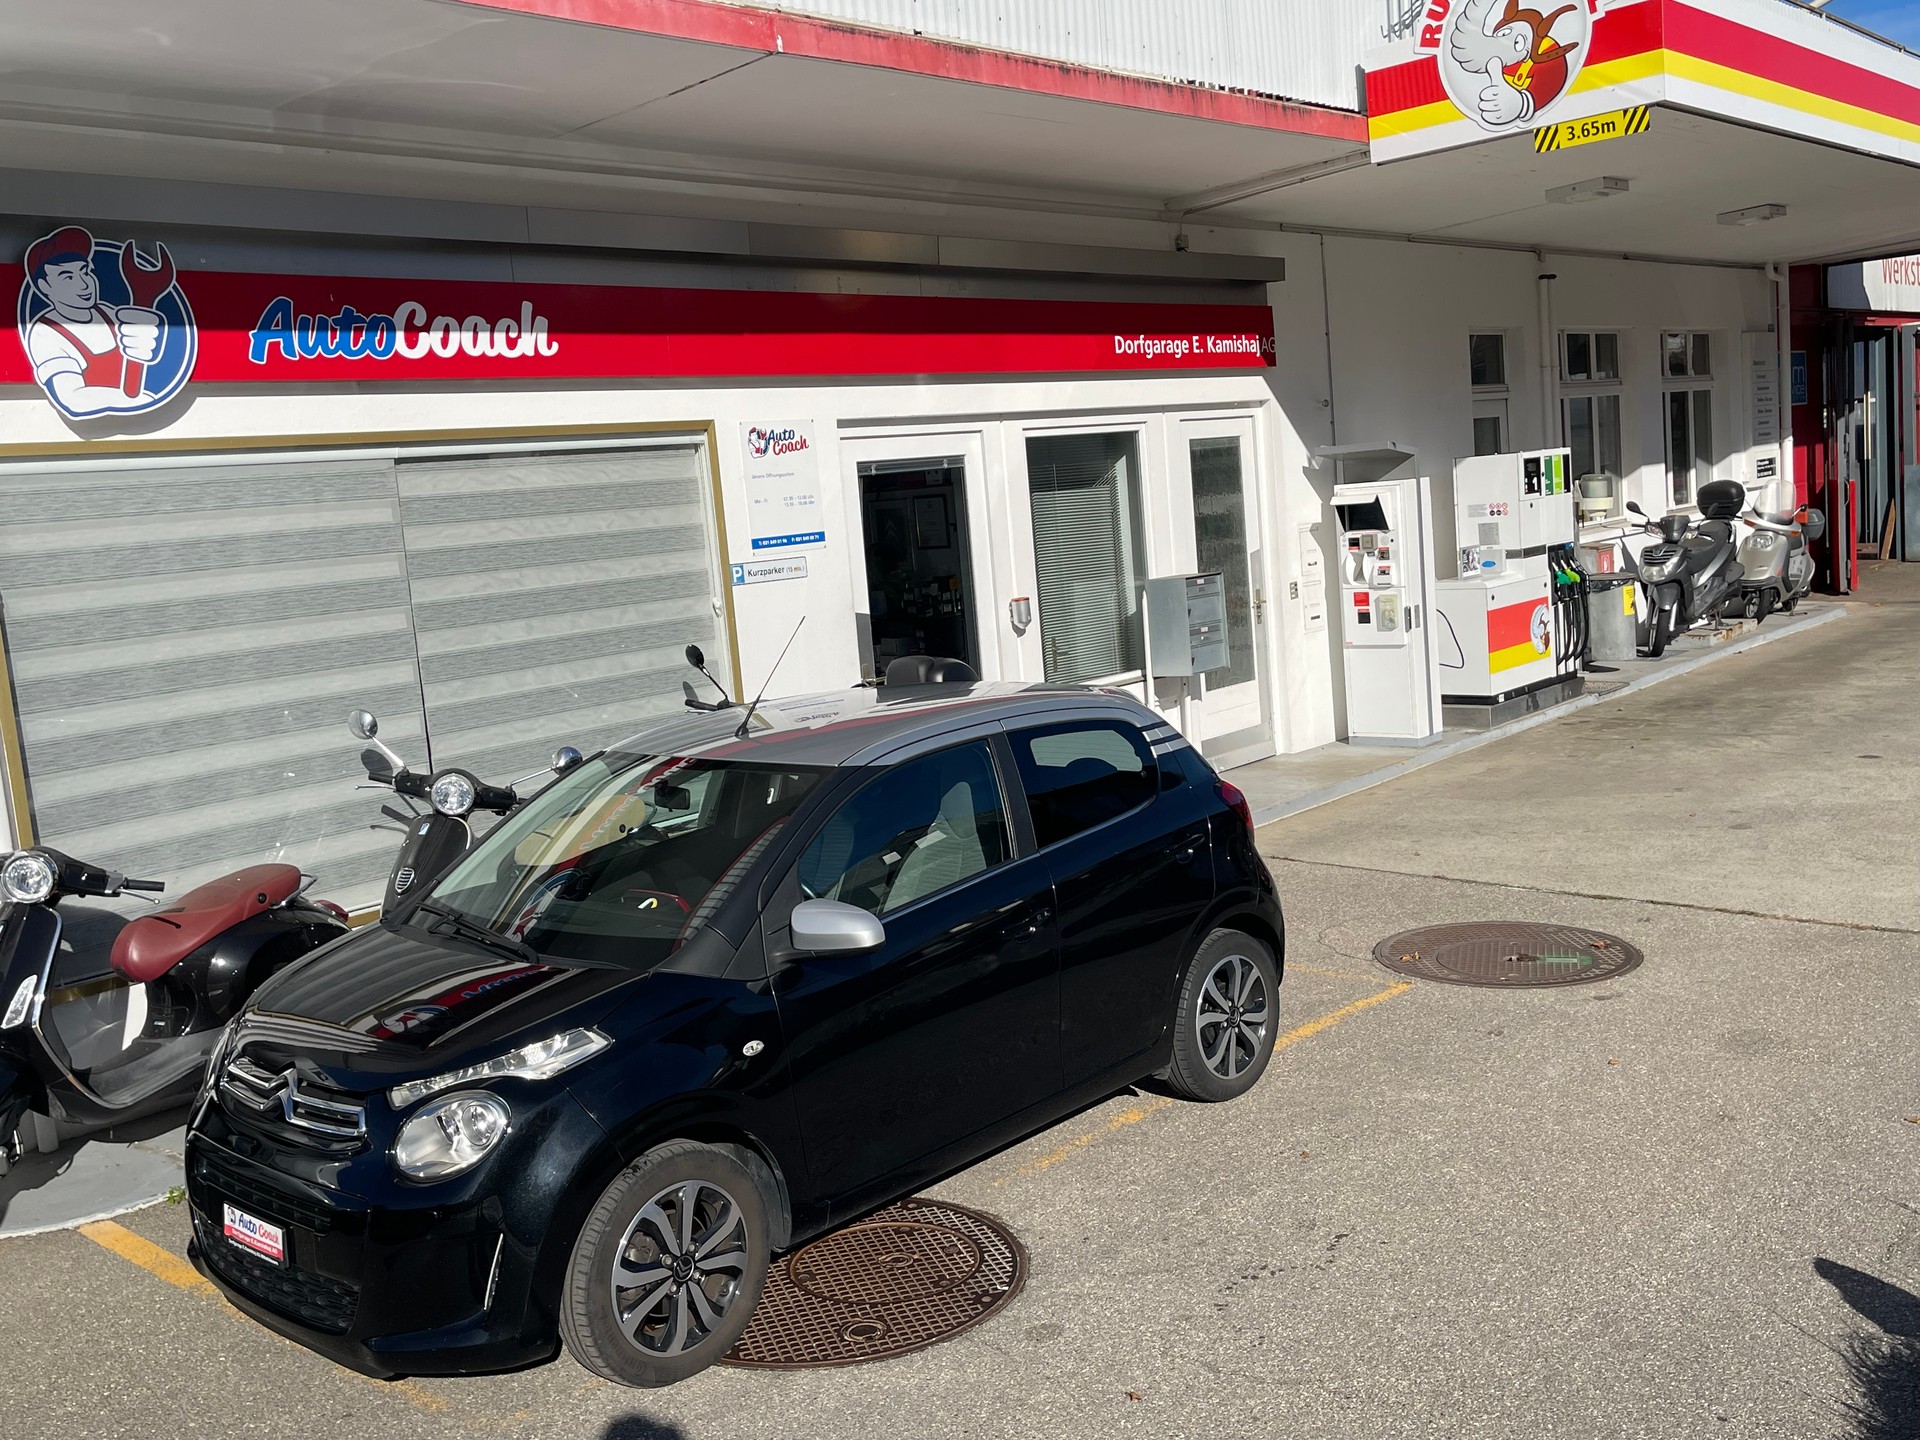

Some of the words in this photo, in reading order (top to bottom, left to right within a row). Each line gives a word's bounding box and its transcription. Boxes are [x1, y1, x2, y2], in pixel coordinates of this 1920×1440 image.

[1566, 118, 1617, 141] 3.65m
[1114, 334, 1190, 359] Dorfgarage
[1192, 336, 1203, 354] E.
[1206, 334, 1261, 358] Kamishaj
[1261, 336, 1276, 353] AG
[767, 428, 795, 446] Auto
[773, 434, 810, 456] Coach
[747, 566, 785, 578] Kurzparker
[238, 1213, 257, 1235] Auto
